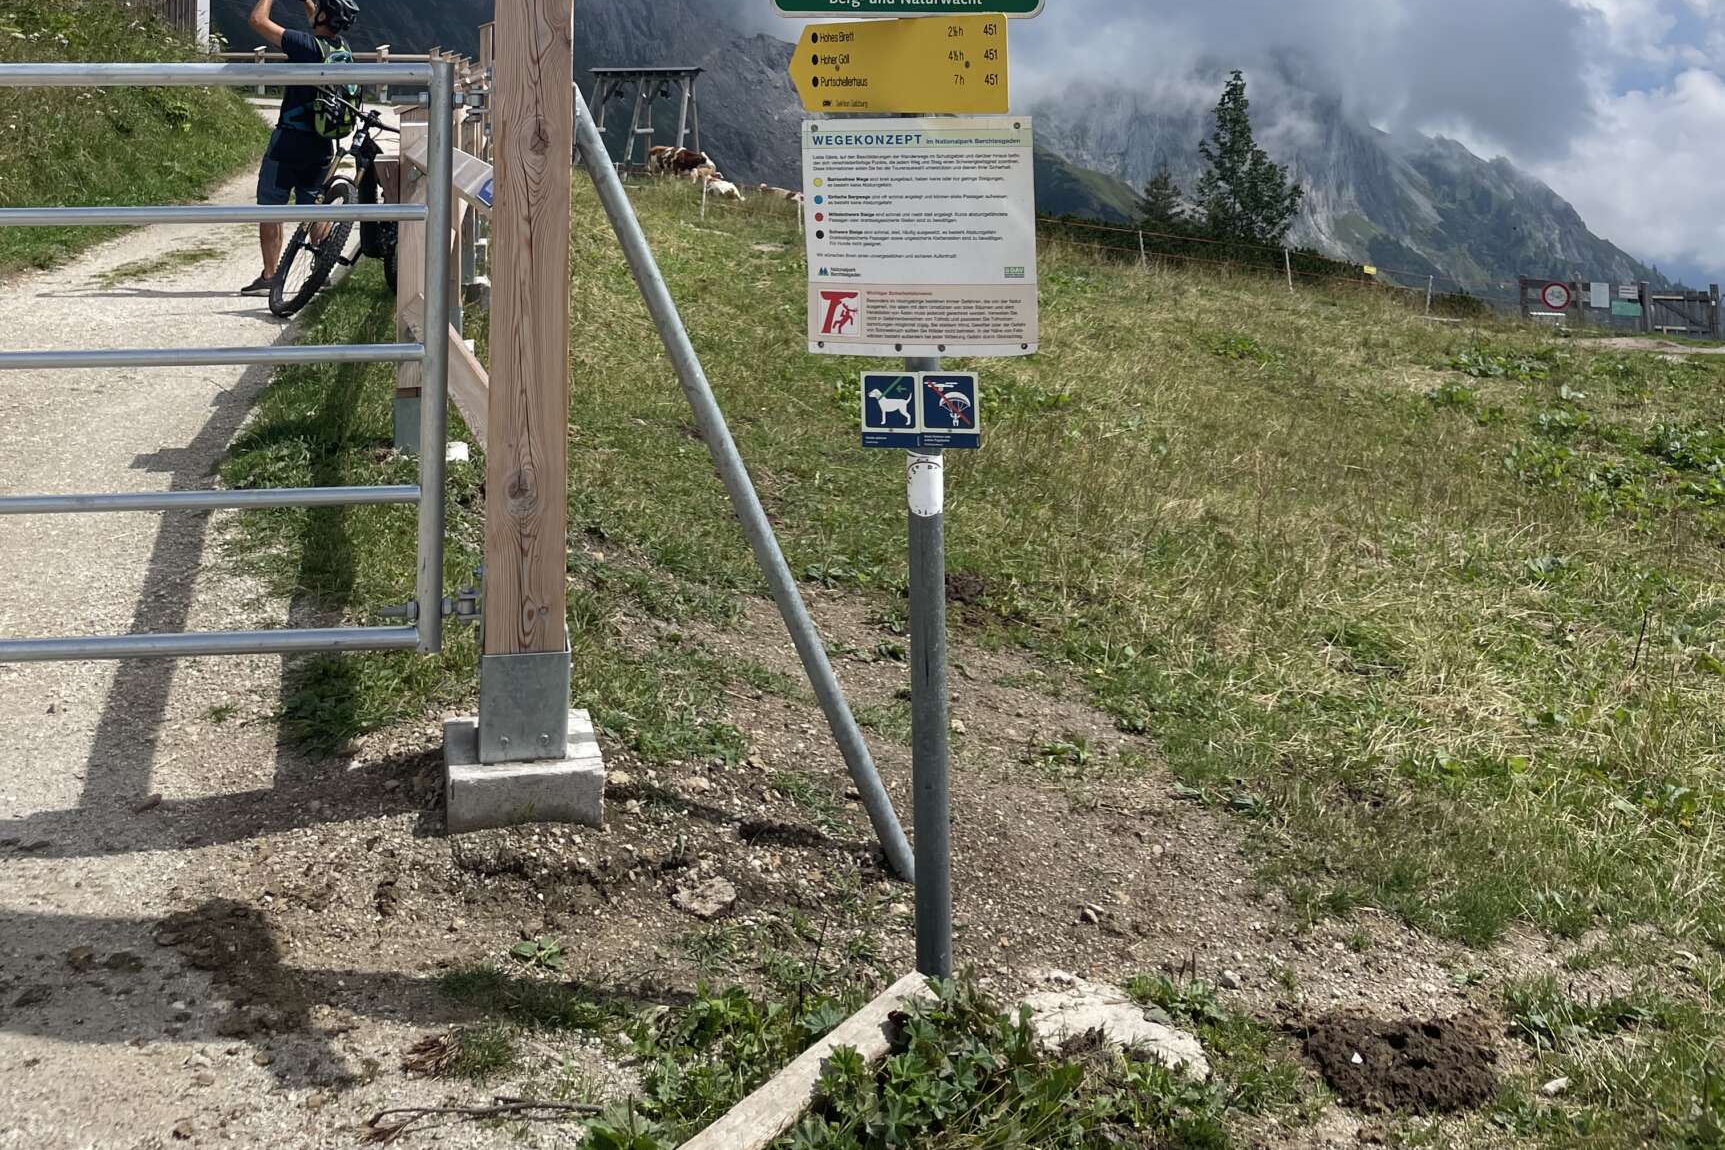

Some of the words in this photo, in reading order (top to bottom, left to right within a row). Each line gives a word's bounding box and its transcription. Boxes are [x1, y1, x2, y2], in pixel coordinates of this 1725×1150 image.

[983, 23, 997, 36] 451
[819, 33, 839, 43] Hohes
[839, 31, 855, 42] Brett
[820, 54, 838, 64] Hoher
[838, 53, 850, 64] Göll
[983, 48, 998, 61] 451
[820, 75, 868, 87] Purtschellerhaus
[984, 73, 998, 86] 451
[811, 134, 923, 146] WEGEKONZEPT
[934, 138, 973, 146] Nationalpark
